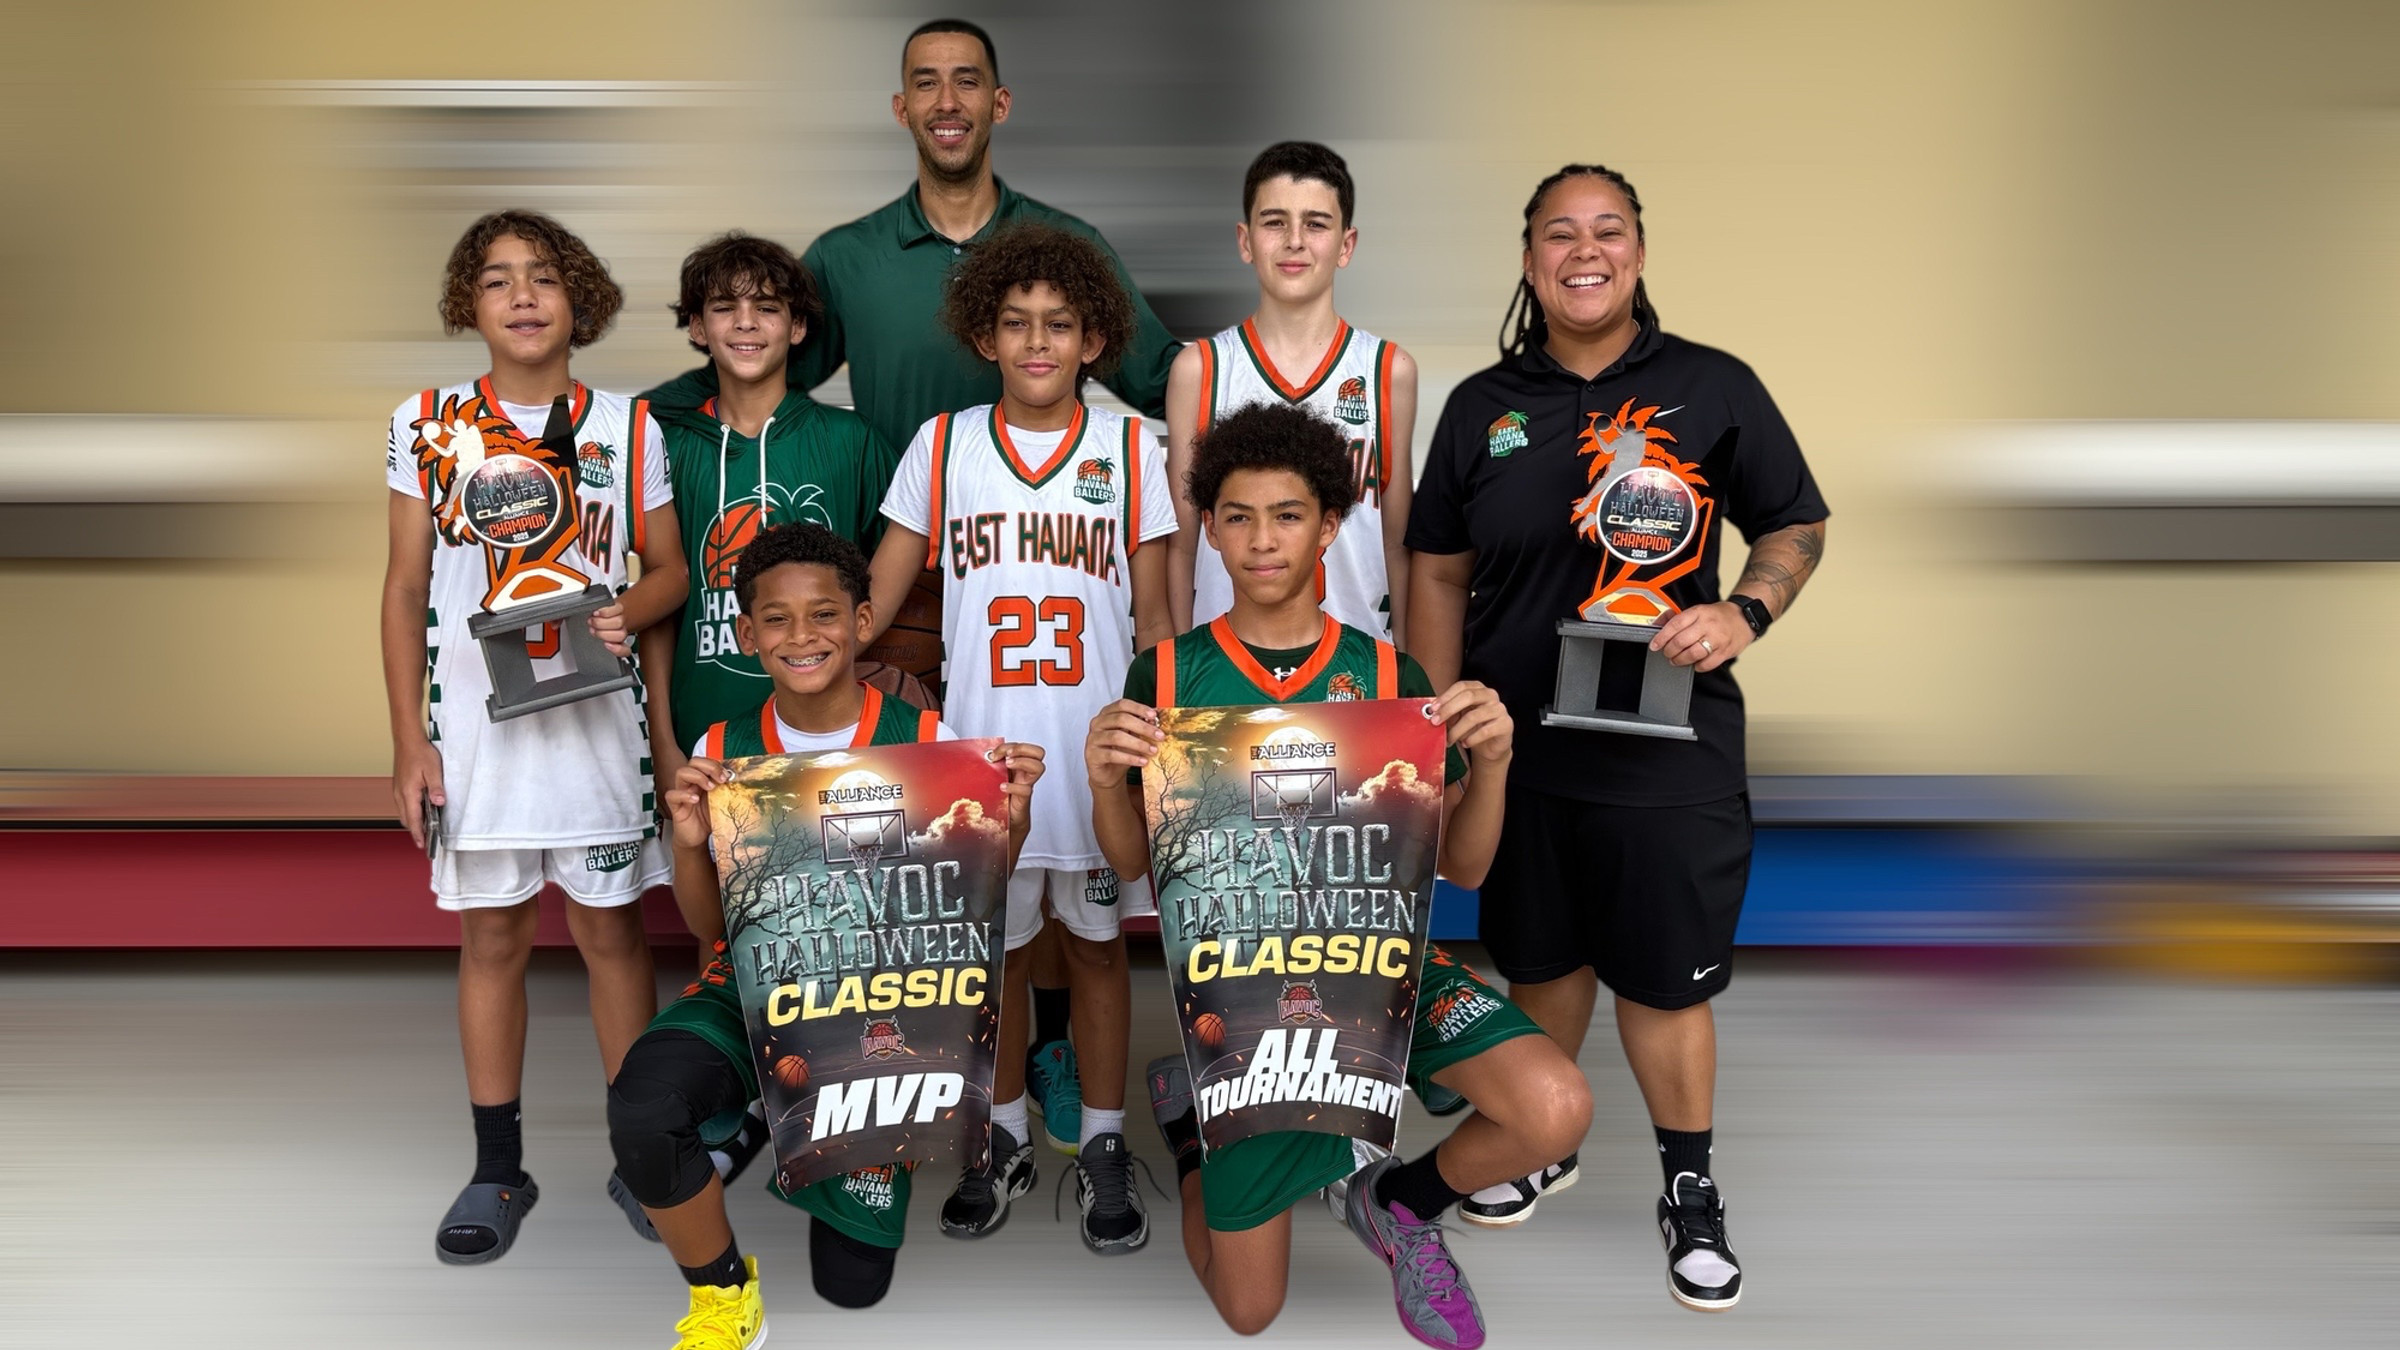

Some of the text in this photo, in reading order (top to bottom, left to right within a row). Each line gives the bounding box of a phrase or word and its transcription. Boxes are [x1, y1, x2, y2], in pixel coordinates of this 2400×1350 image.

[1489, 430, 1525, 446] HAVANA
[580, 468, 615, 488] ALLERS
[1077, 478, 1113, 493] HAVANA
[476, 495, 549, 520] CLASSIC
[1075, 486, 1115, 503] BALLERS
[488, 512, 548, 538] CHAMPION
[1606, 514, 1682, 532] CLASSIC
[949, 512, 1006, 581] EAST
[1612, 531, 1672, 552] CHAMPION
[987, 595, 1085, 687] 23
[1258, 742, 1336, 760] ALLIANCE
[826, 783, 904, 805] ALLIANCE
[586, 847, 640, 870] BALLERS
[1198, 824, 1392, 891] HAVOC
[772, 860, 965, 936] HAVOC
[1176, 888, 1418, 941] HALLOWEEN
[751, 921, 992, 986] HALLOWEEN
[1187, 934, 1411, 984] CLASSIC
[766, 966, 988, 1028] CLASSIC
[1438, 995, 1488, 1034] HAVANA
[1246, 1028, 1339, 1075] ALL
[810, 1072, 965, 1142] MVP
[1199, 1072, 1402, 1124] TOURNAMENT
[860, 1171, 886, 1183] EAST
